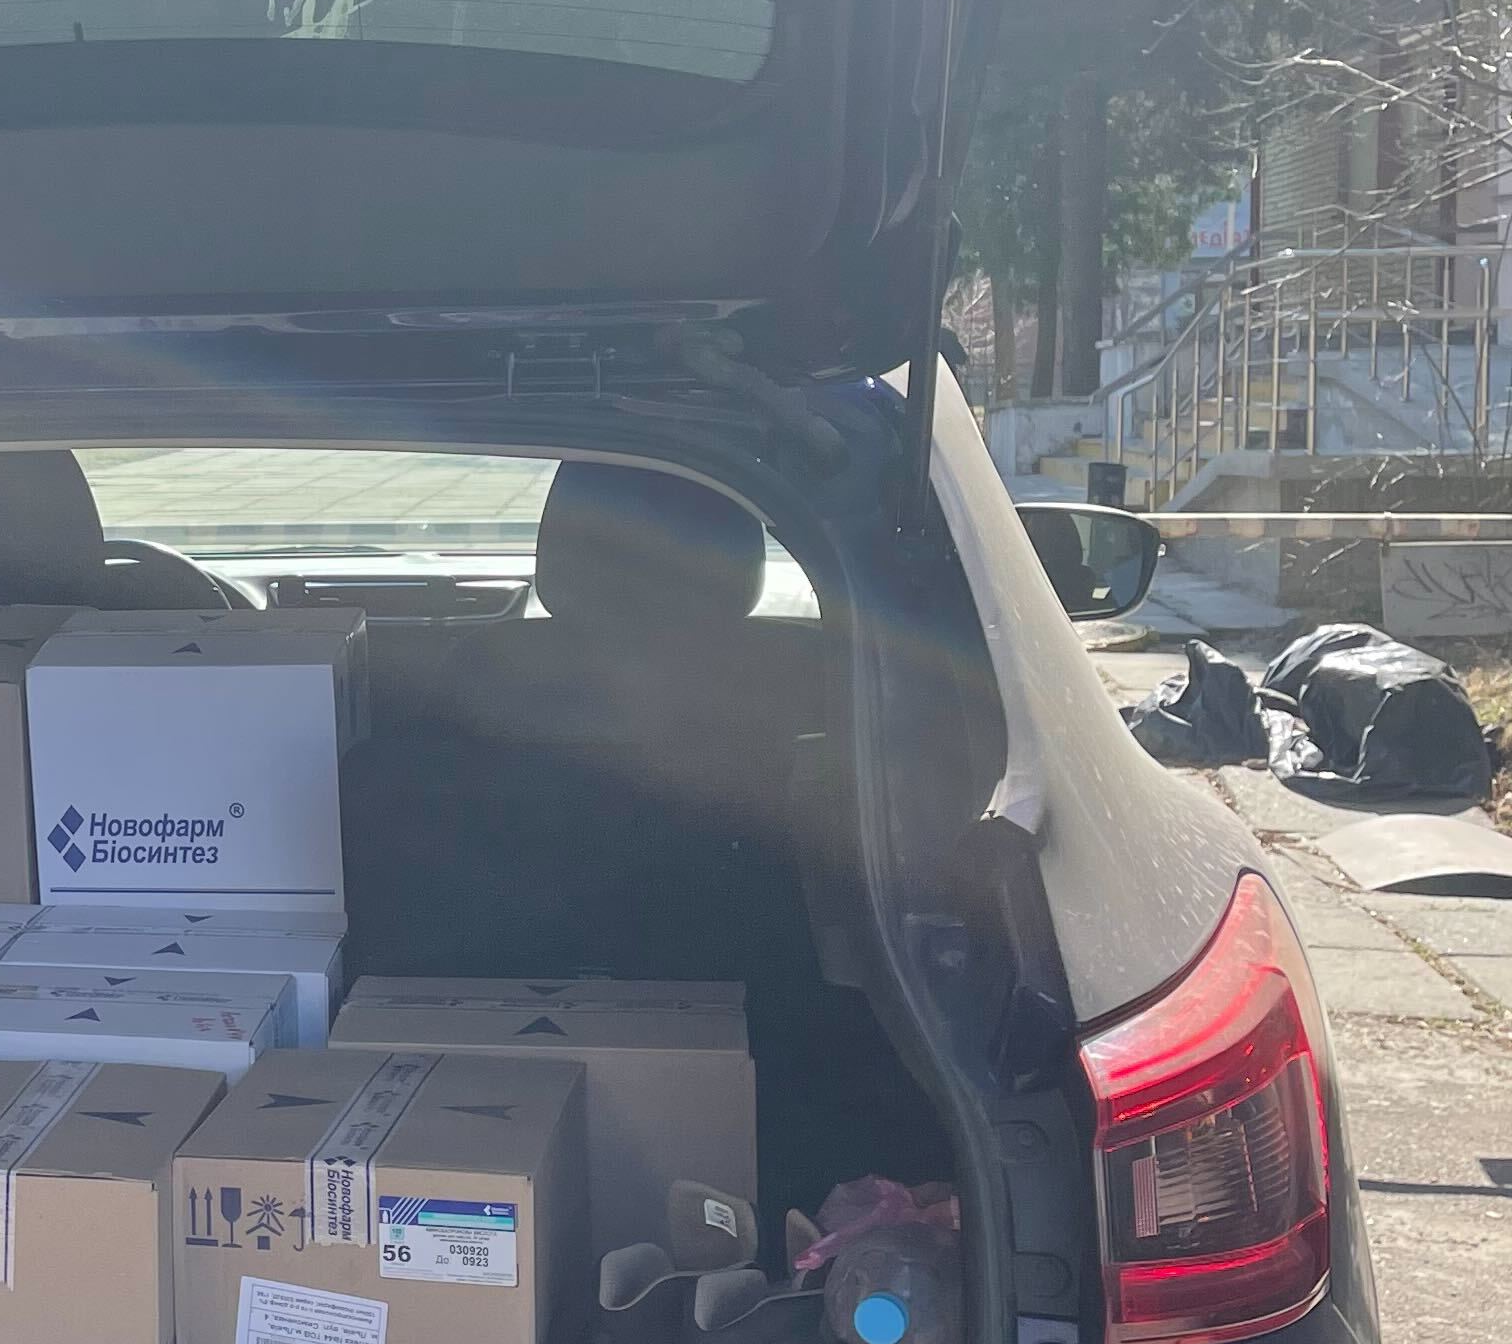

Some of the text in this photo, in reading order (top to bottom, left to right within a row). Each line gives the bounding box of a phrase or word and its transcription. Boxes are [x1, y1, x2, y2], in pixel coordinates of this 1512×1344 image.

[89, 813, 225, 843] Новофарм
[91, 839, 219, 864] Біосинтез
[327, 1169, 340, 1237] Біосинтез
[338, 1169, 355, 1242] Новофарм
[382, 1244, 412, 1263] 56
[434, 1255, 489, 1267] До 0923
[449, 1244, 489, 1257] 030920
